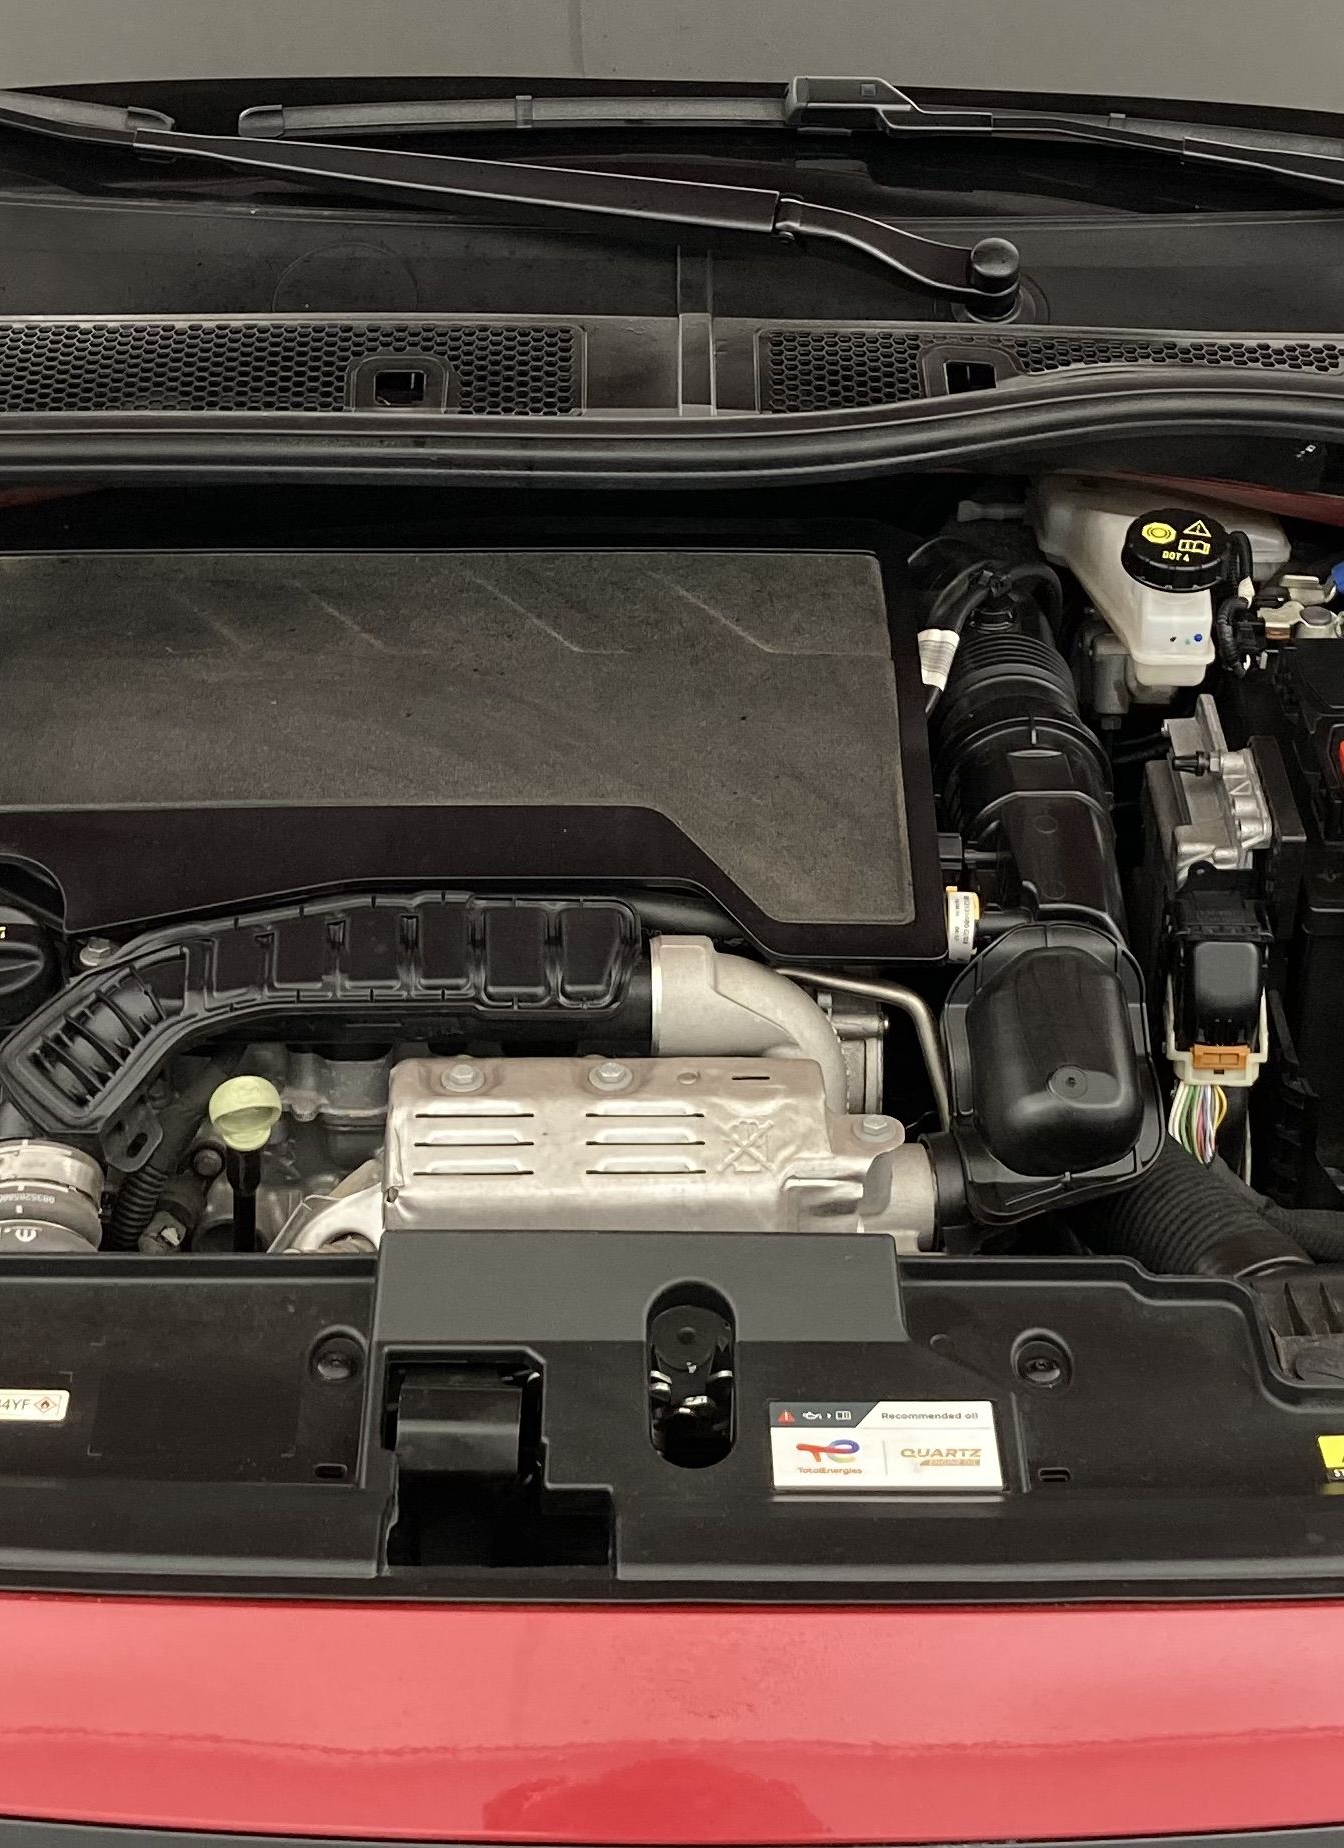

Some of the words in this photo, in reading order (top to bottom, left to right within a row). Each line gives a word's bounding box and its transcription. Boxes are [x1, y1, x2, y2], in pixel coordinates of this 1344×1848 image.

[1162, 551, 1182, 561] DOT
[1182, 553, 1190, 562] 4
[881, 1411, 962, 1420] Recommended
[965, 1411, 978, 1420] oil
[900, 1448, 982, 1458] QUARTZ
[797, 1466, 862, 1476] TotalEnergies
